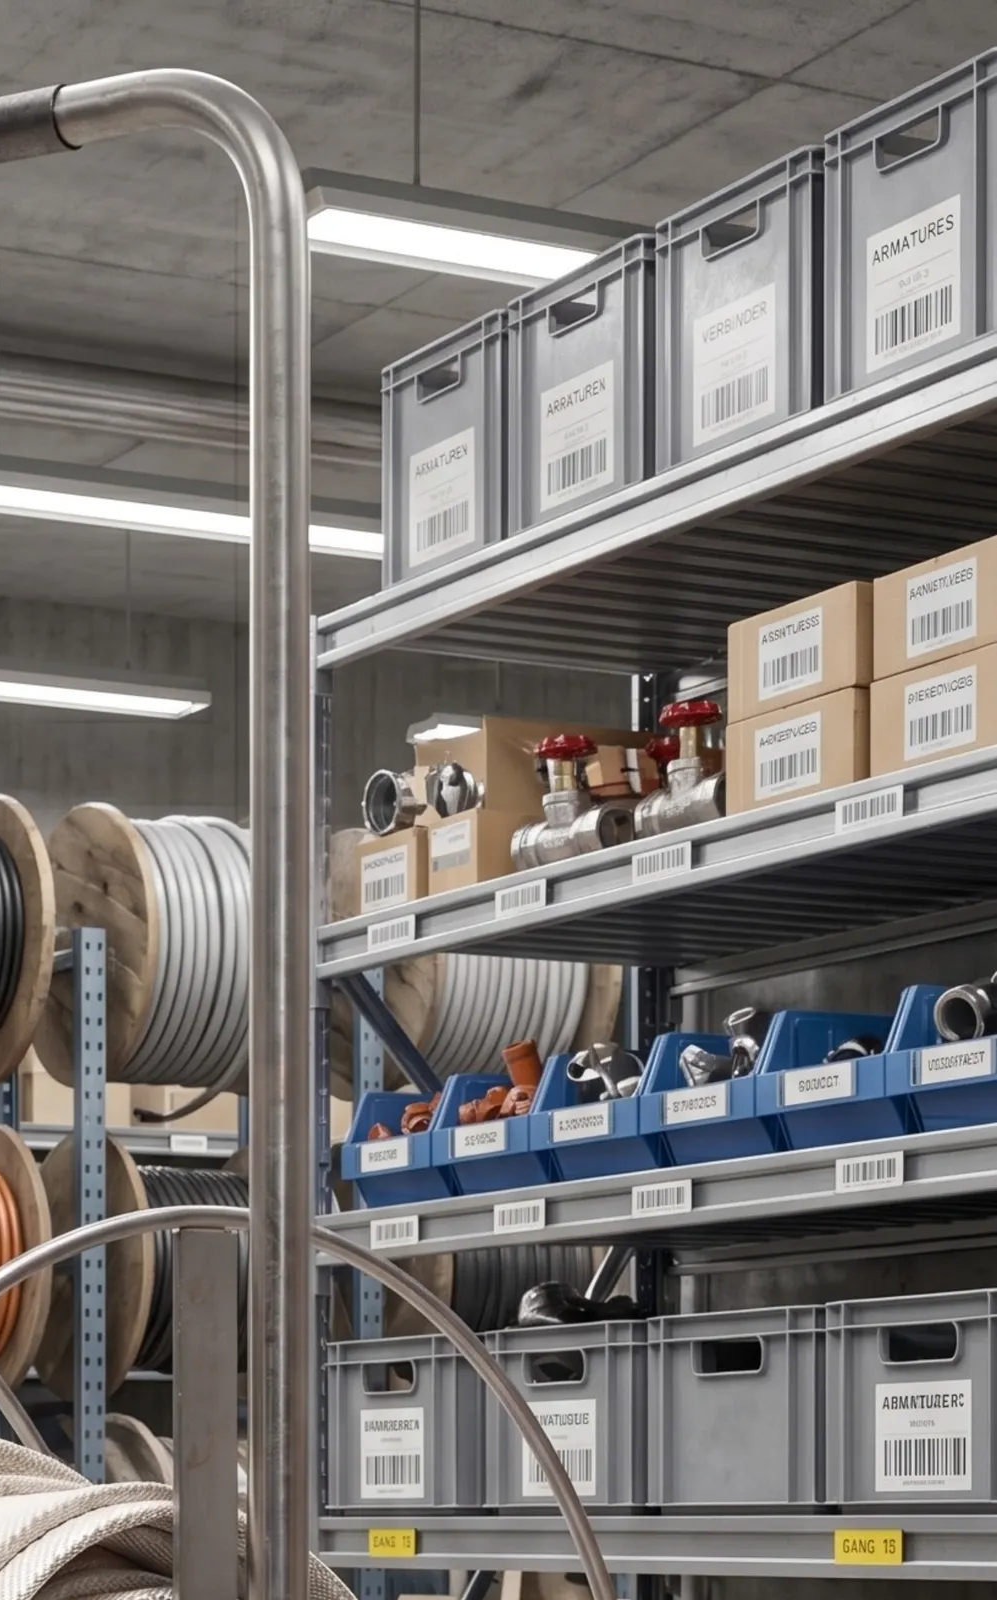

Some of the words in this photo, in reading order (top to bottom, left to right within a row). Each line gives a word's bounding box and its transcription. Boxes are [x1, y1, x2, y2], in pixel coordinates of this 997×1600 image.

[872, 214, 955, 266] ARMATURES
[702, 301, 767, 343] VERBINDER
[842, 1538, 875, 1554] GANG
[882, 1538, 896, 1554] 15
